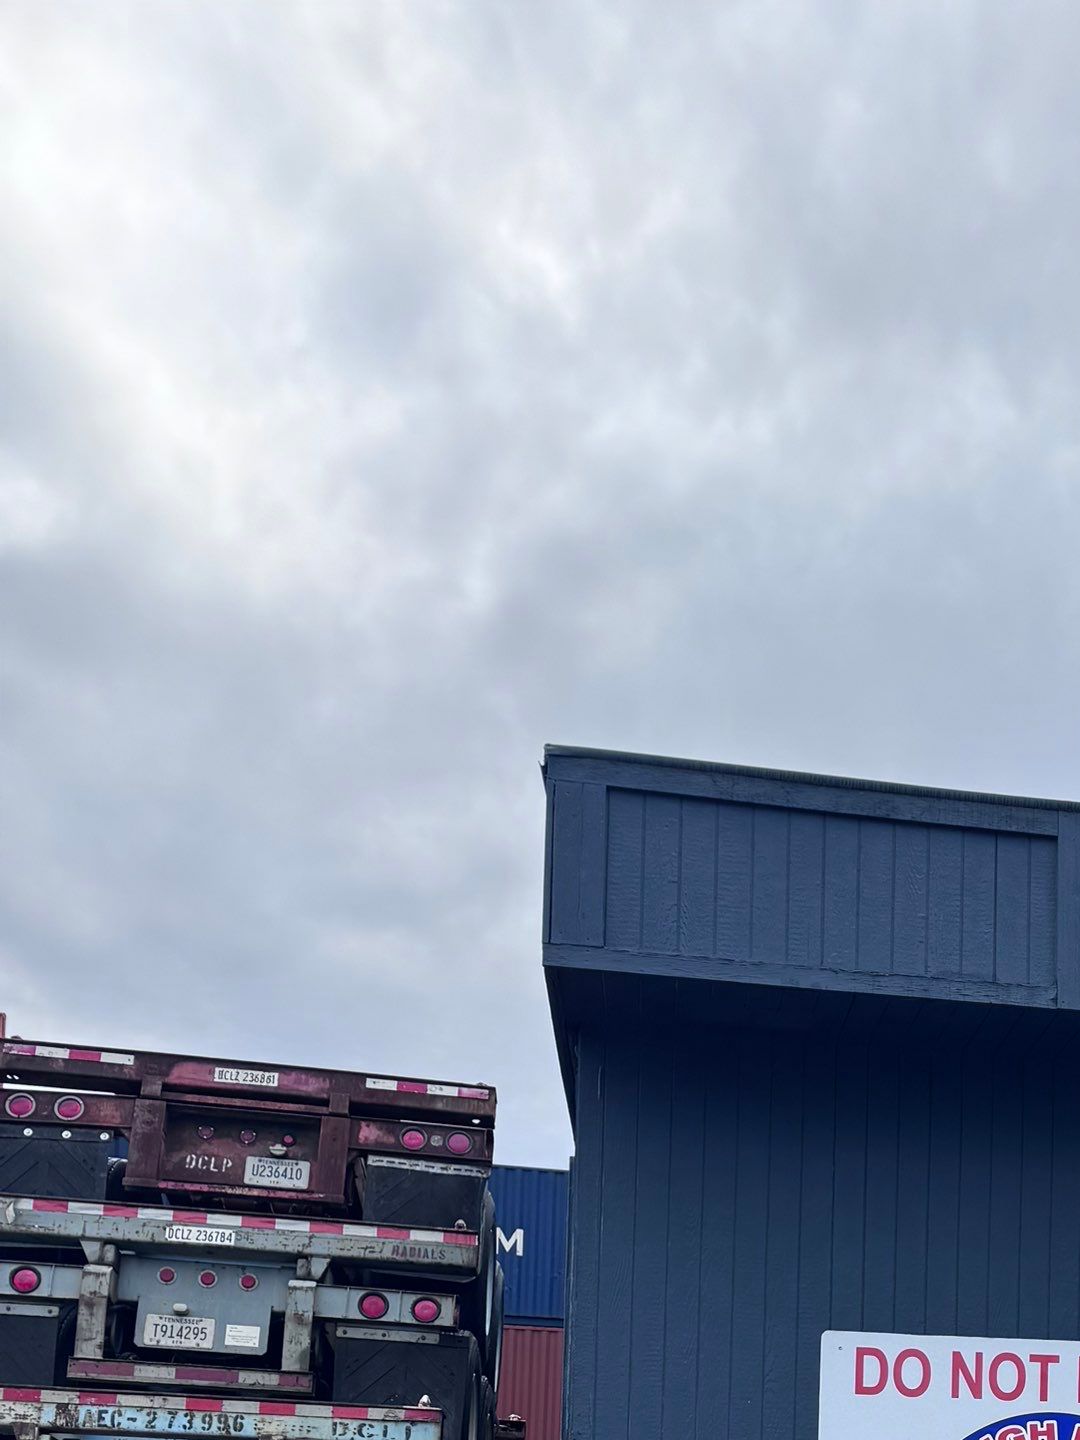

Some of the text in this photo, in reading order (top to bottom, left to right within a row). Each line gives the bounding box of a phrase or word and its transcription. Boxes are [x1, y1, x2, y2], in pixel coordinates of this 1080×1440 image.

[251, 1163, 303, 1180] U236410
[168, 1227, 192, 1241] DCLZ
[195, 1229, 233, 1243] 236784
[391, 1245, 446, 1260] RADIALS
[152, 1323, 208, 1341] T914295
[854, 1346, 932, 1398] DO
[950, 1350, 1060, 1402] NOT
